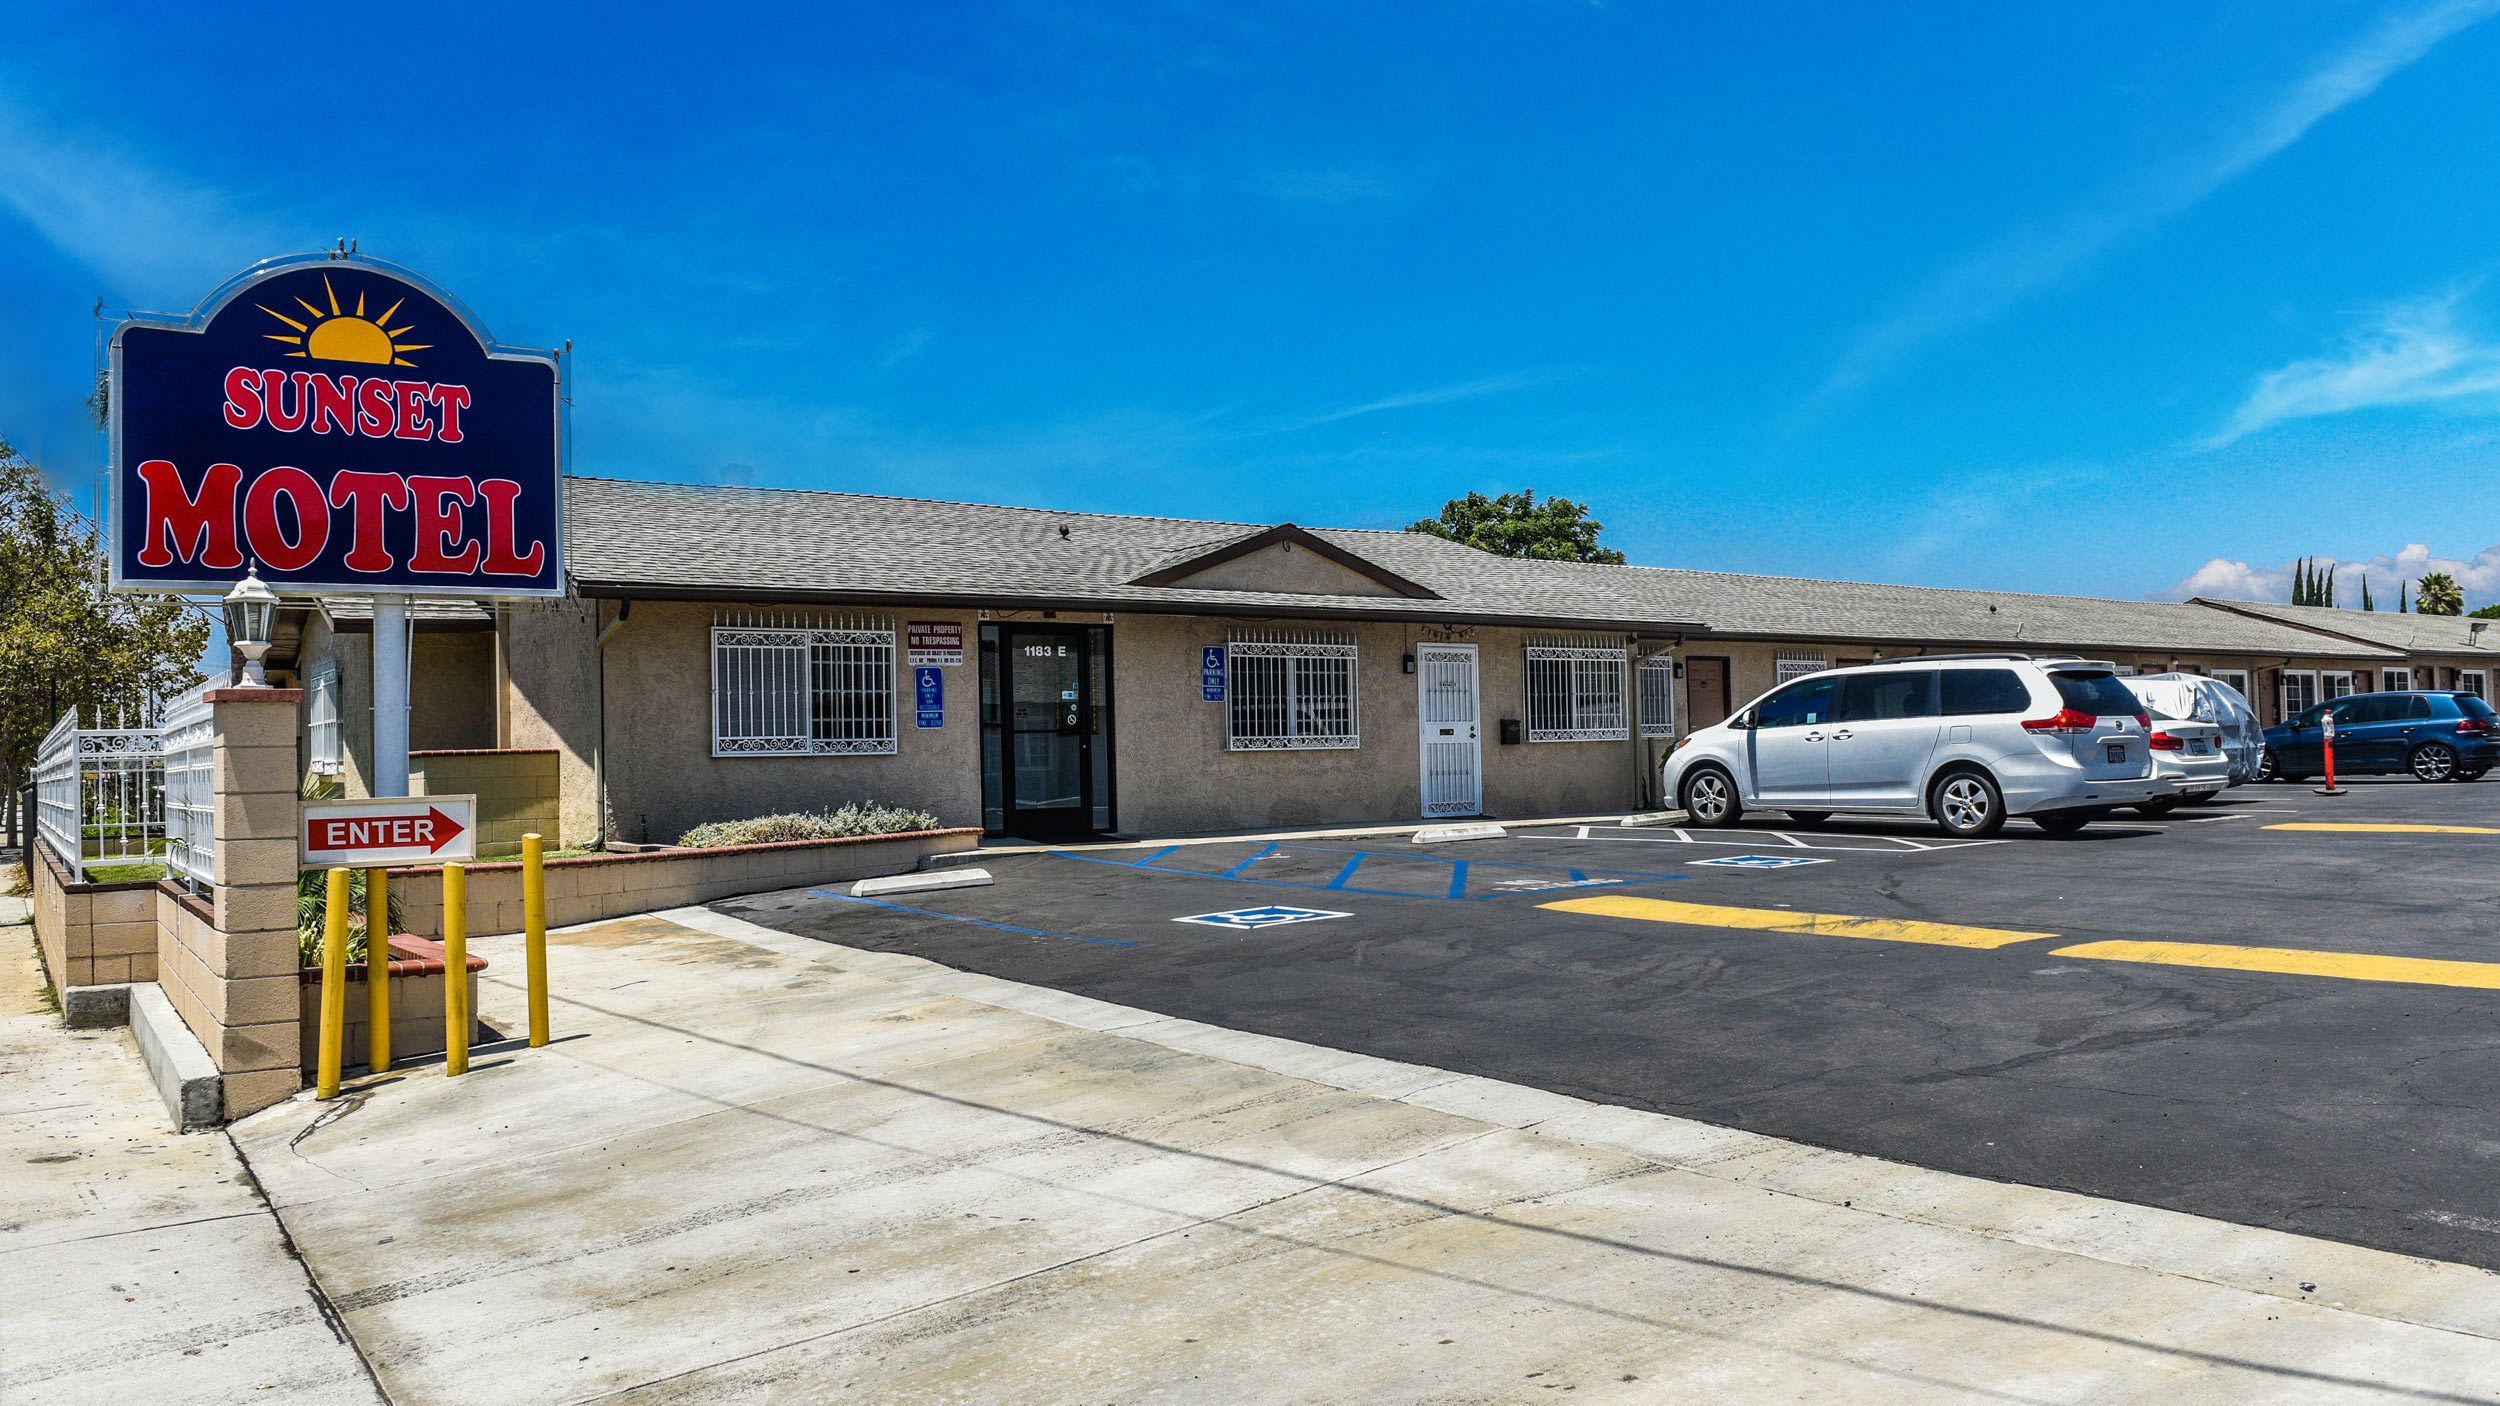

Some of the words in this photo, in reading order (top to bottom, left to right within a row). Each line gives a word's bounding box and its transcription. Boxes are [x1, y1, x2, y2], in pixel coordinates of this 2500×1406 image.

[223, 366, 471, 443] SUNSET
[137, 460, 545, 577] MOTEL
[908, 624, 931, 634] PRIVATE
[933, 625, 962, 634] PROPERTY
[911, 636, 920, 645] NO
[922, 636, 960, 646] TRESPASSING
[1024, 645, 1052, 657] 1183
[1058, 645, 1067, 657] E
[1204, 668, 1224, 676] PARKING
[1208, 677, 1220, 685] ONLY
[327, 819, 436, 846] ENTER
